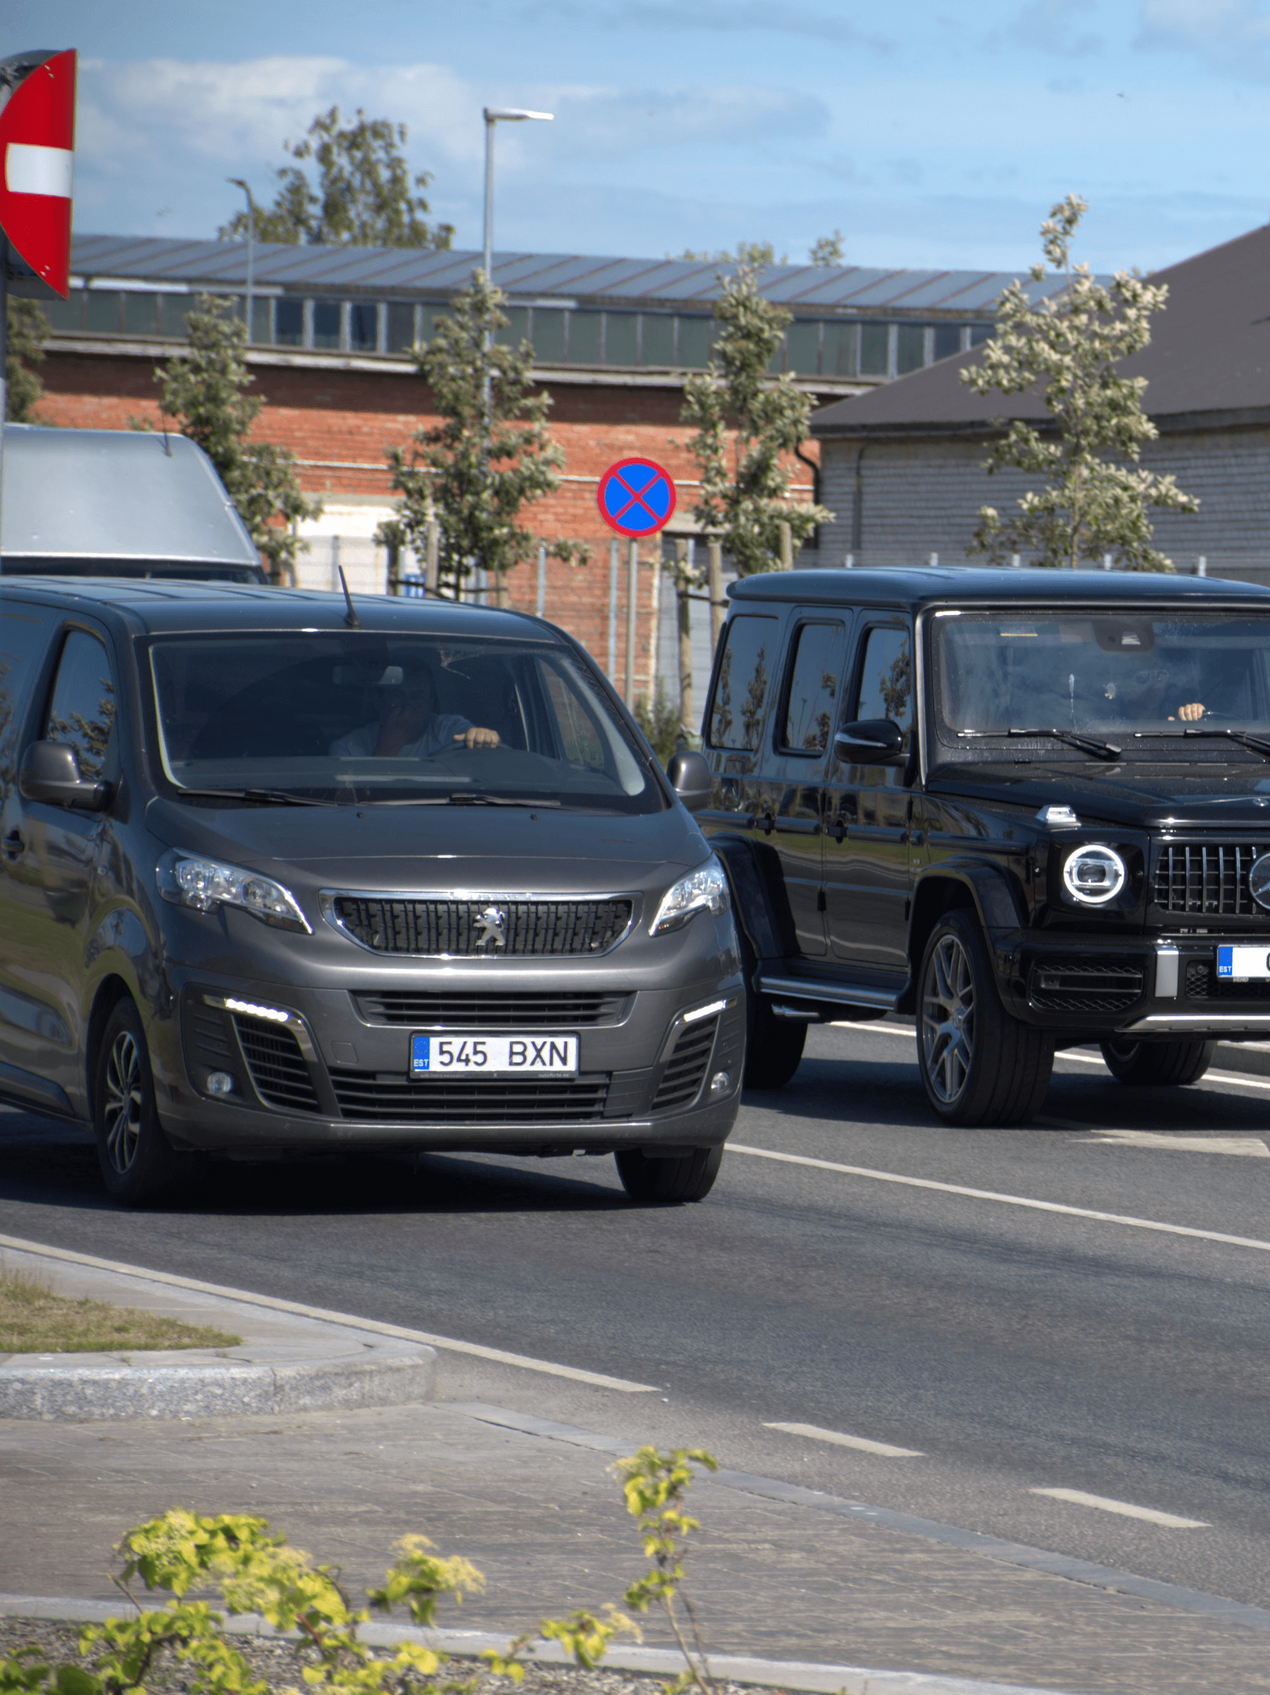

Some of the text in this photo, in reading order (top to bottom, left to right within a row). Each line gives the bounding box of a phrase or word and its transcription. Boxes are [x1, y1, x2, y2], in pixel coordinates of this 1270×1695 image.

[439, 1041, 568, 1067] 545 BXN
[413, 1059, 428, 1067] EST
